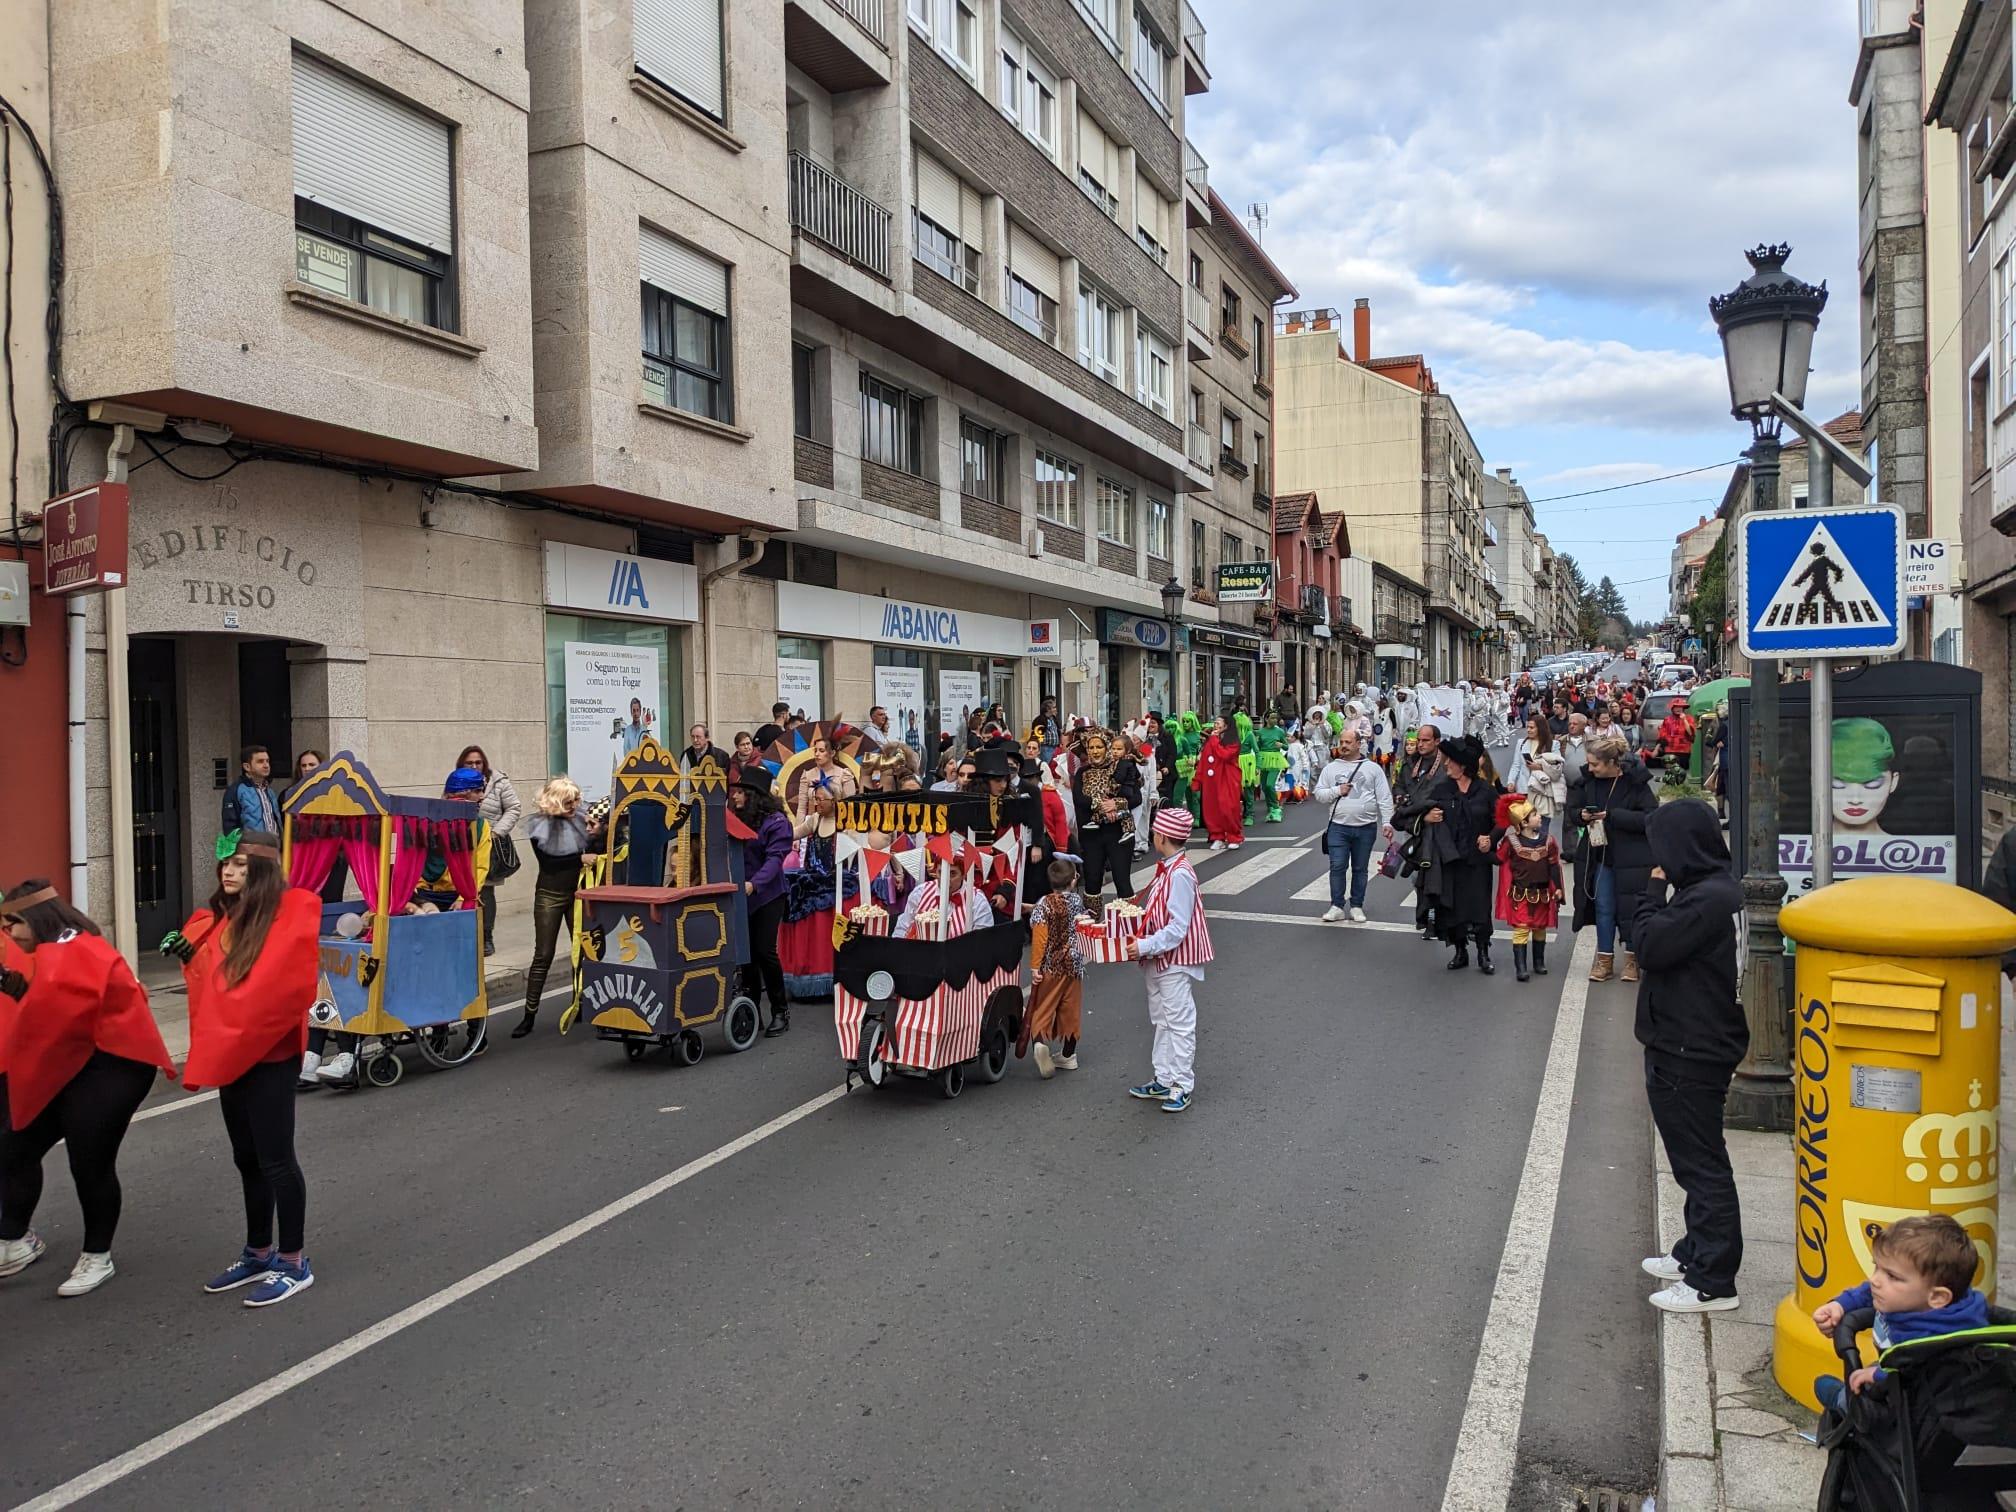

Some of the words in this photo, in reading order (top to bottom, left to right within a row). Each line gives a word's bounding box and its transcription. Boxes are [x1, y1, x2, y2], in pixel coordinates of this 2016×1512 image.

[297, 237, 311, 254] SE
[312, 242, 347, 267] VENDE
[65, 534, 97, 560] ANTONIO
[132, 525, 317, 587] EDIFICIO
[1905, 563, 1935, 572] rreiro
[183, 579, 276, 610] TIRSO
[1906, 584, 1944, 592] IENTES
[889, 604, 961, 645] ABANCA
[585, 661, 593, 672] O
[594, 661, 619, 675] Seguro
[622, 676, 641, 690] Fogar
[836, 801, 948, 834] PALOMITAS
[1778, 838, 1947, 871] RioL@n
[582, 974, 664, 1027] TAQUILLA
[1796, 991, 1830, 1289] CORREOS
